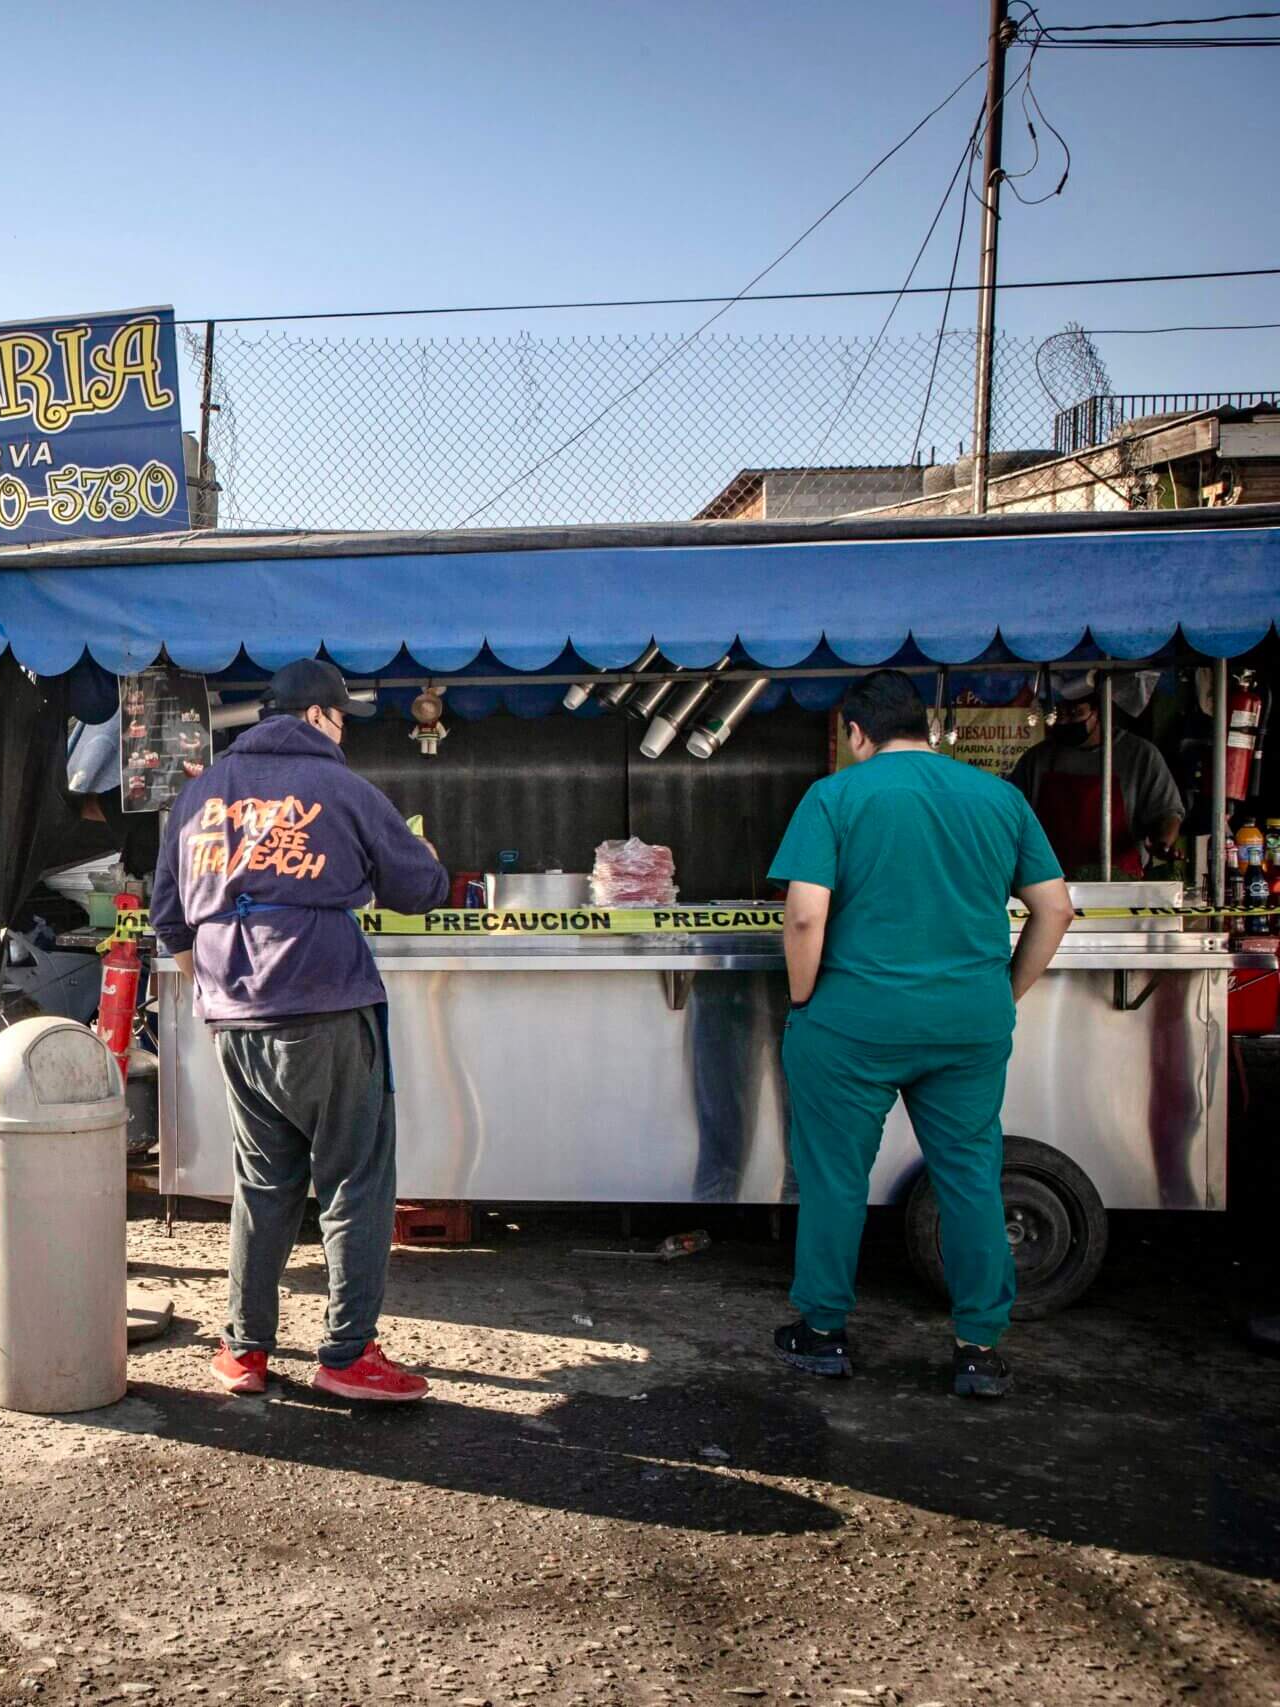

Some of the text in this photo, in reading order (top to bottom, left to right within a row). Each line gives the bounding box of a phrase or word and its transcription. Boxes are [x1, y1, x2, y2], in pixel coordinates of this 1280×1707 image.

[956, 725, 1031, 739] UESADILLAS
[265, 828, 310, 850] SEE
[425, 911, 611, 931] PRECAUCIÓN
